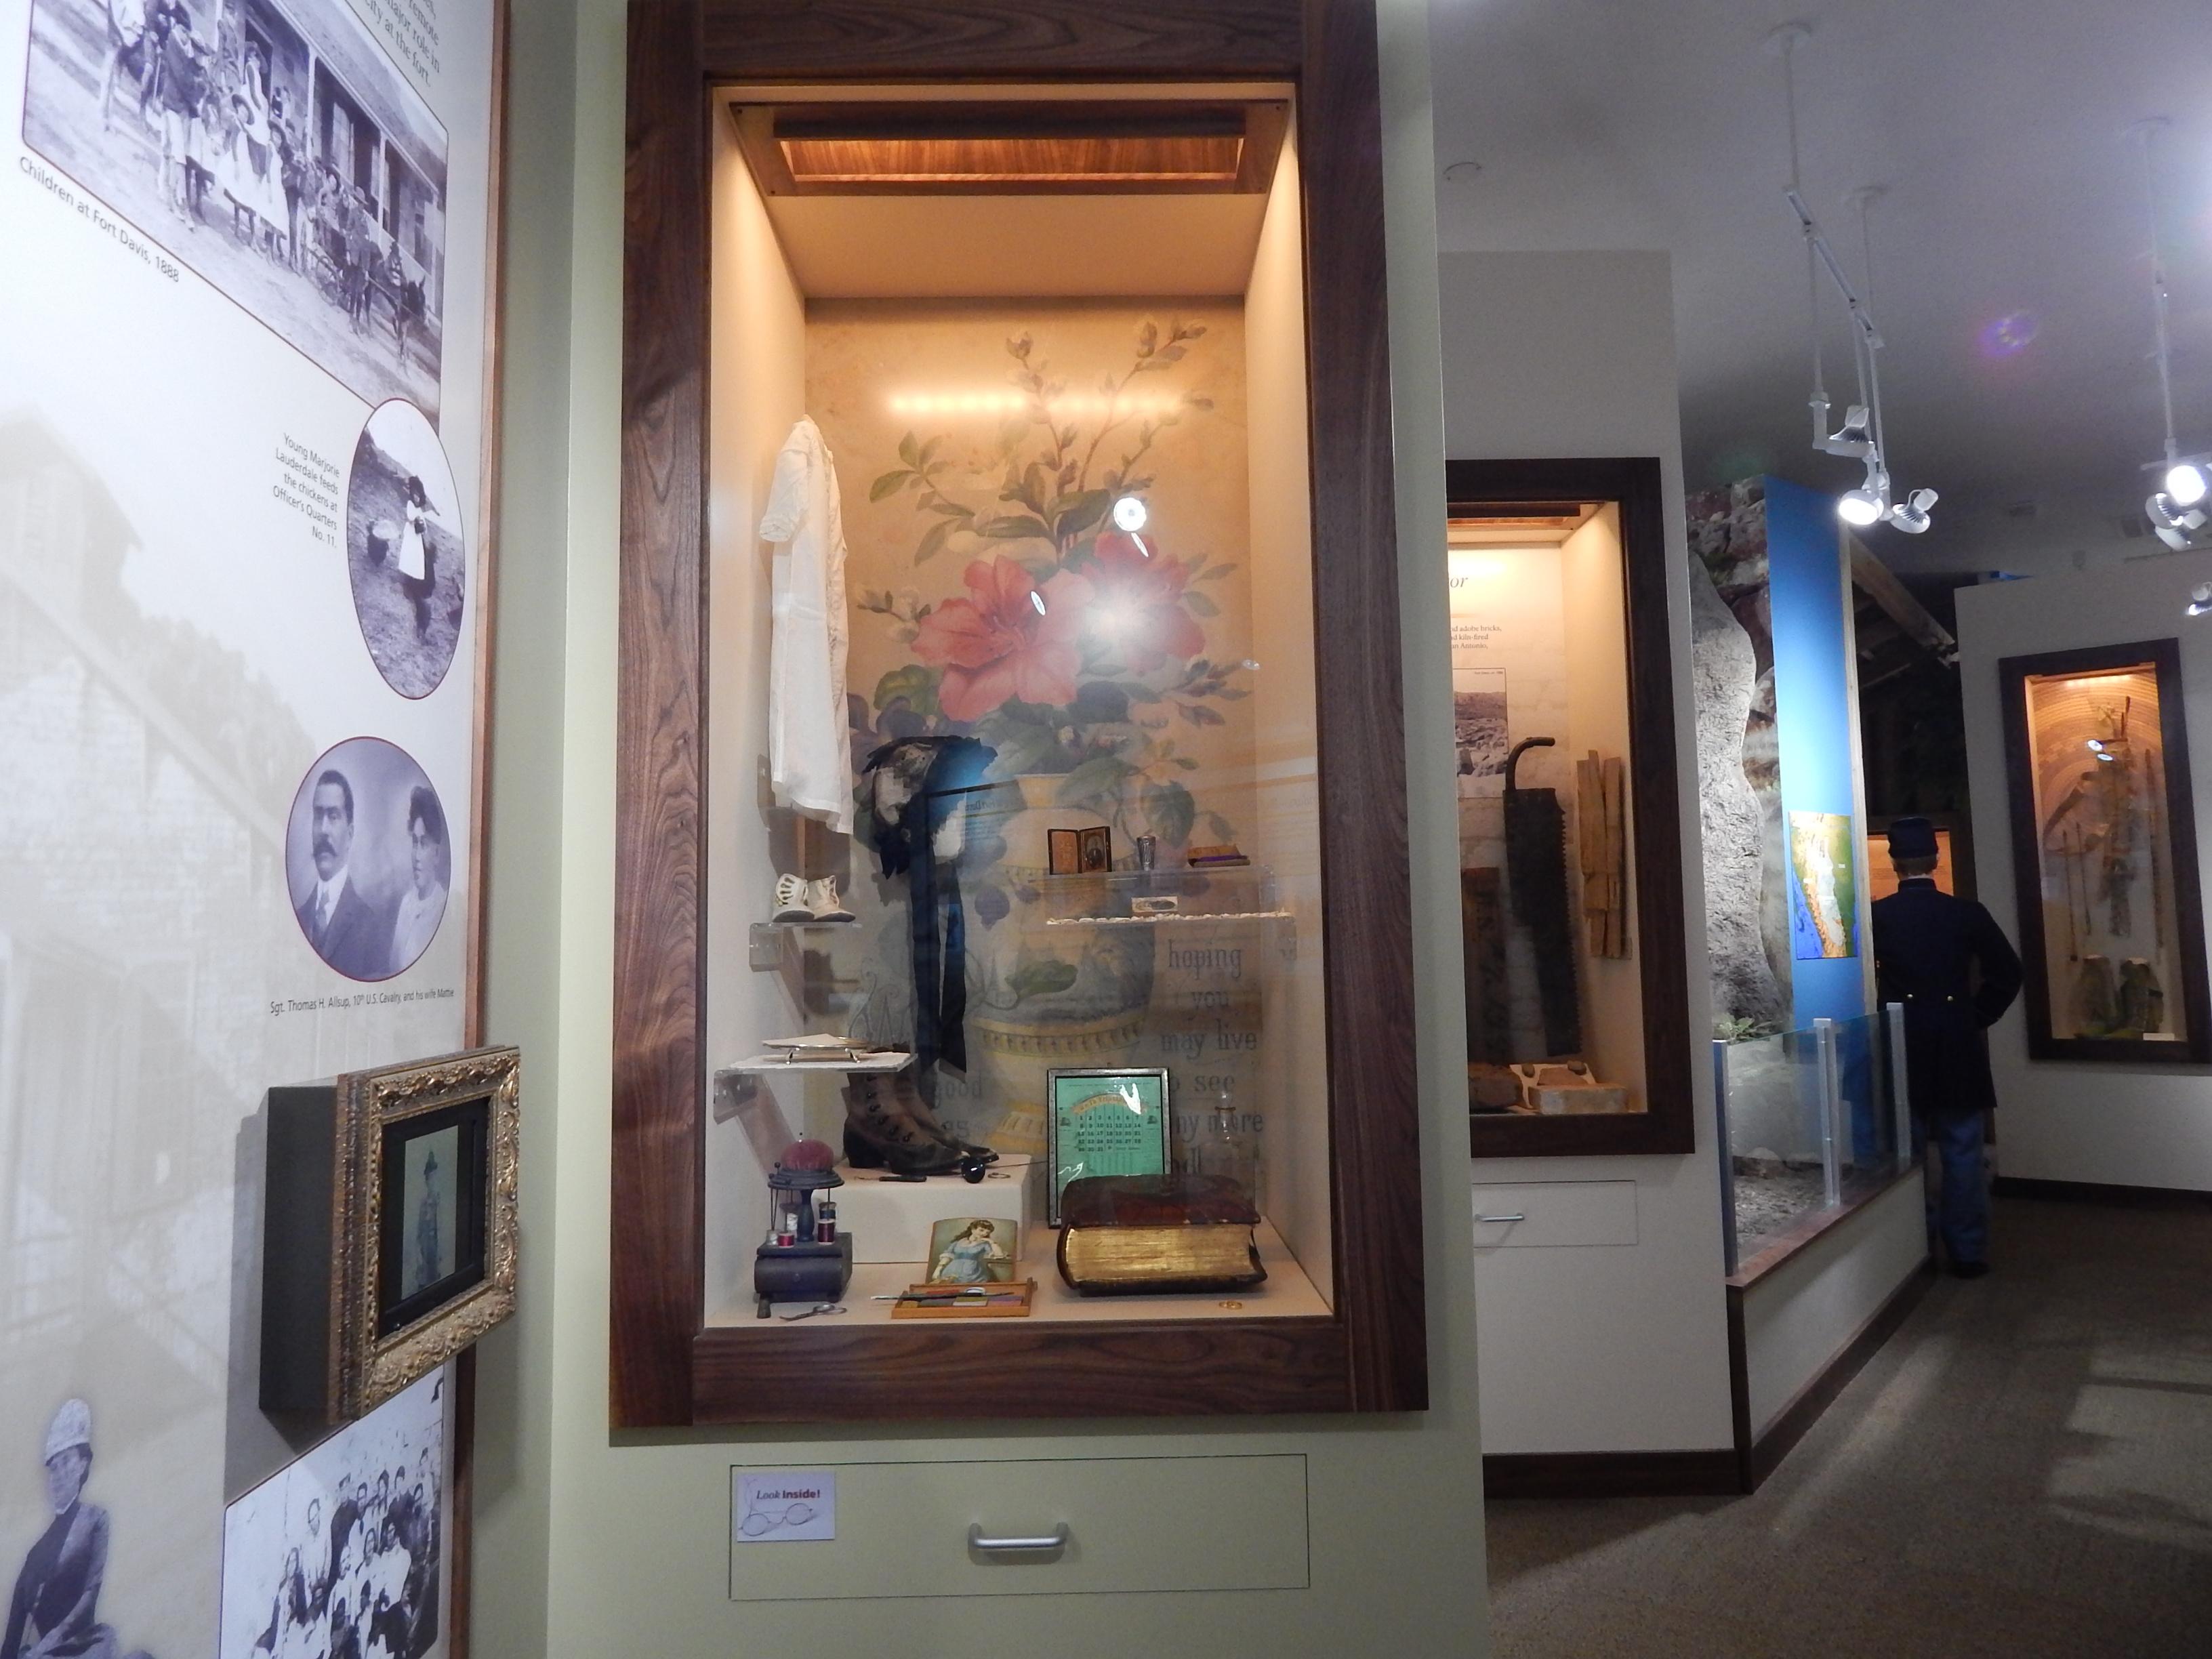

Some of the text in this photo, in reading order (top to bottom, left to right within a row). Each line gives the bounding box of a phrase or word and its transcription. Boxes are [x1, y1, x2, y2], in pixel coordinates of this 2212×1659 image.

[385, 18, 394, 39] at
[396, 31, 411, 60] the
[412, 52, 431, 87] fort.
[413, 29, 430, 59] role
[431, 50, 440, 73] in
[19, 157, 180, 283] Children at Fort Davis, 1888
[276, 447, 339, 495] Lauderdale feeds
[283, 432, 340, 478] Young Marjorie
[273, 485, 337, 530] Officer's Quarters
[284, 473, 337, 513] the chickens at
[312, 526, 337, 548] No. 11.
[1480, 624, 1502, 632] bricks,
[1168, 939, 1242, 979] hoping
[270, 1001, 285, 1017] Sgt.
[288, 1000, 317, 1011] Thomas
[319, 998, 326, 1008] H.
[328, 996, 351, 1009] Allsup,
[366, 994, 378, 1004] U.S.
[380, 992, 402, 1004] Cavalry,
[403, 990, 414, 1002] and
[415, 989, 424, 1000] his
[424, 988, 436, 1000] wife
[1187, 991, 1230, 1021] you
[1160, 1018, 1258, 1060] may live
[1195, 1075, 1235, 1092] see
[756, 1488, 820, 1500] Look Inside!
